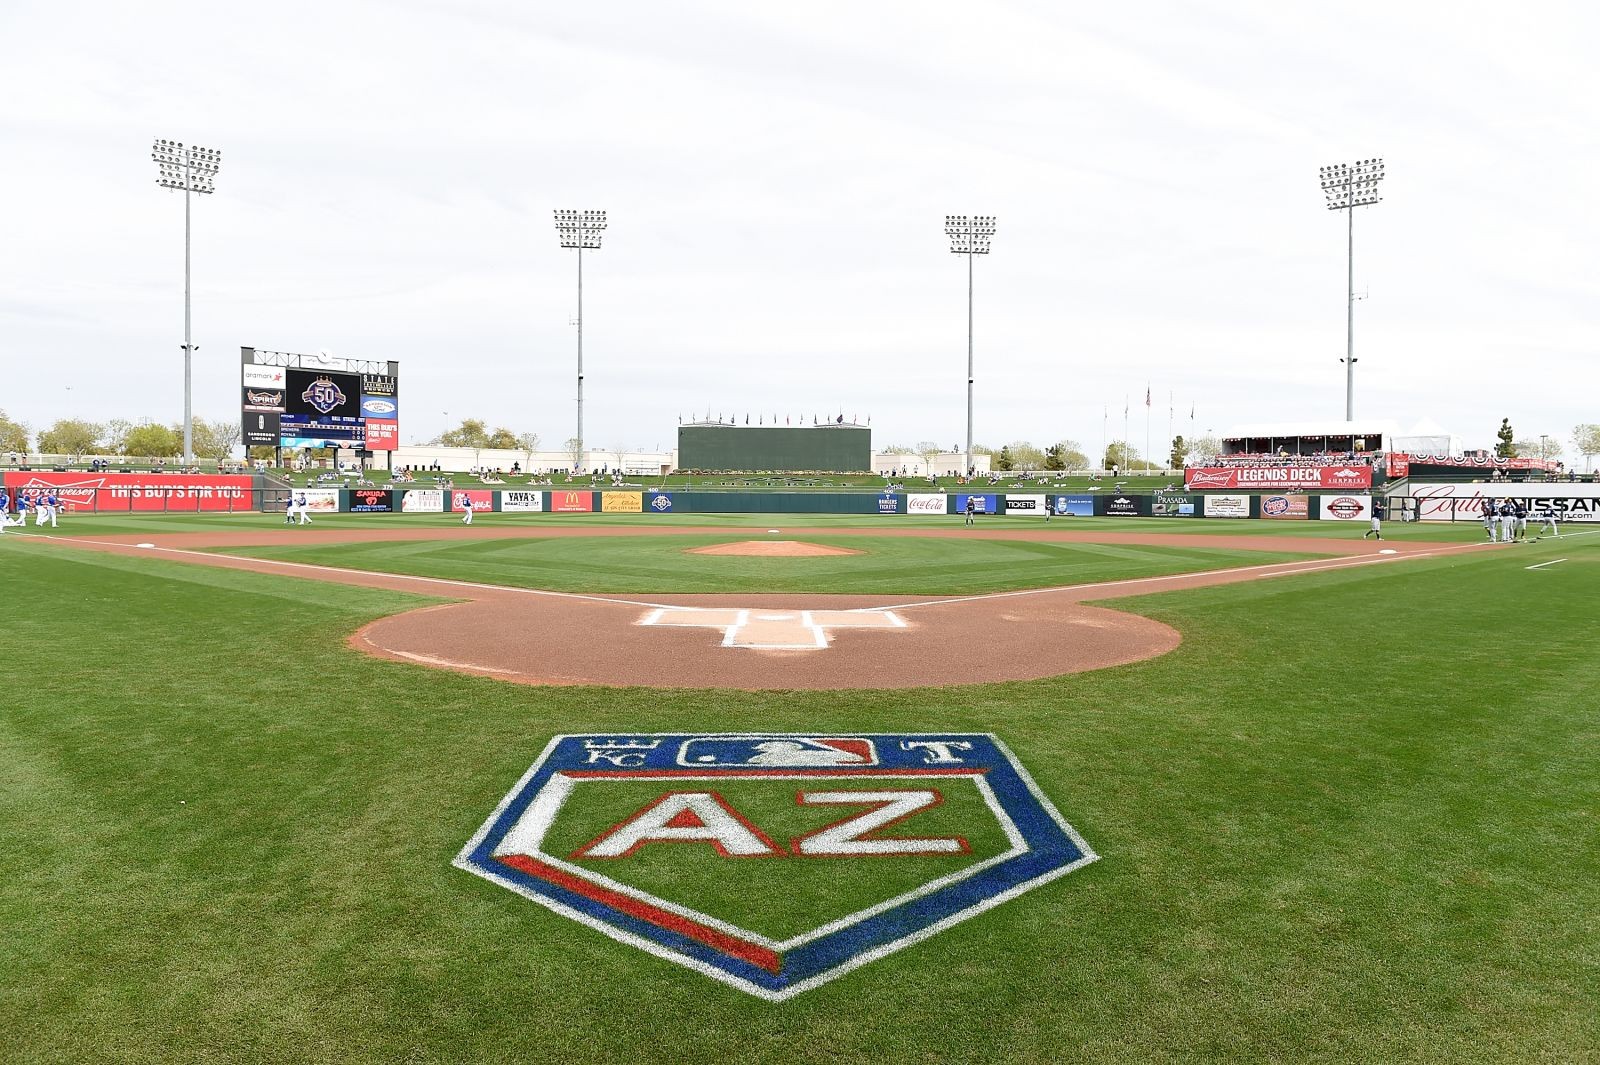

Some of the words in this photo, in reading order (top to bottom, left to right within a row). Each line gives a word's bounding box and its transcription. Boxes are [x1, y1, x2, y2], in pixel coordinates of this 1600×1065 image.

[363, 374, 394, 384] STATE
[315, 387, 334, 403] 50
[1194, 473, 1229, 482] Budweiser
[1237, 469, 1289, 481] LEGENDS
[1291, 469, 1321, 481] DECK
[109, 485, 141, 498] THIS
[144, 485, 184, 498] BUD'S
[190, 485, 213, 498] FOR
[658, 499, 666, 507] 50
[902, 740, 972, 764] T
[588, 750, 645, 768] KC
[568, 789, 972, 859] AZ
